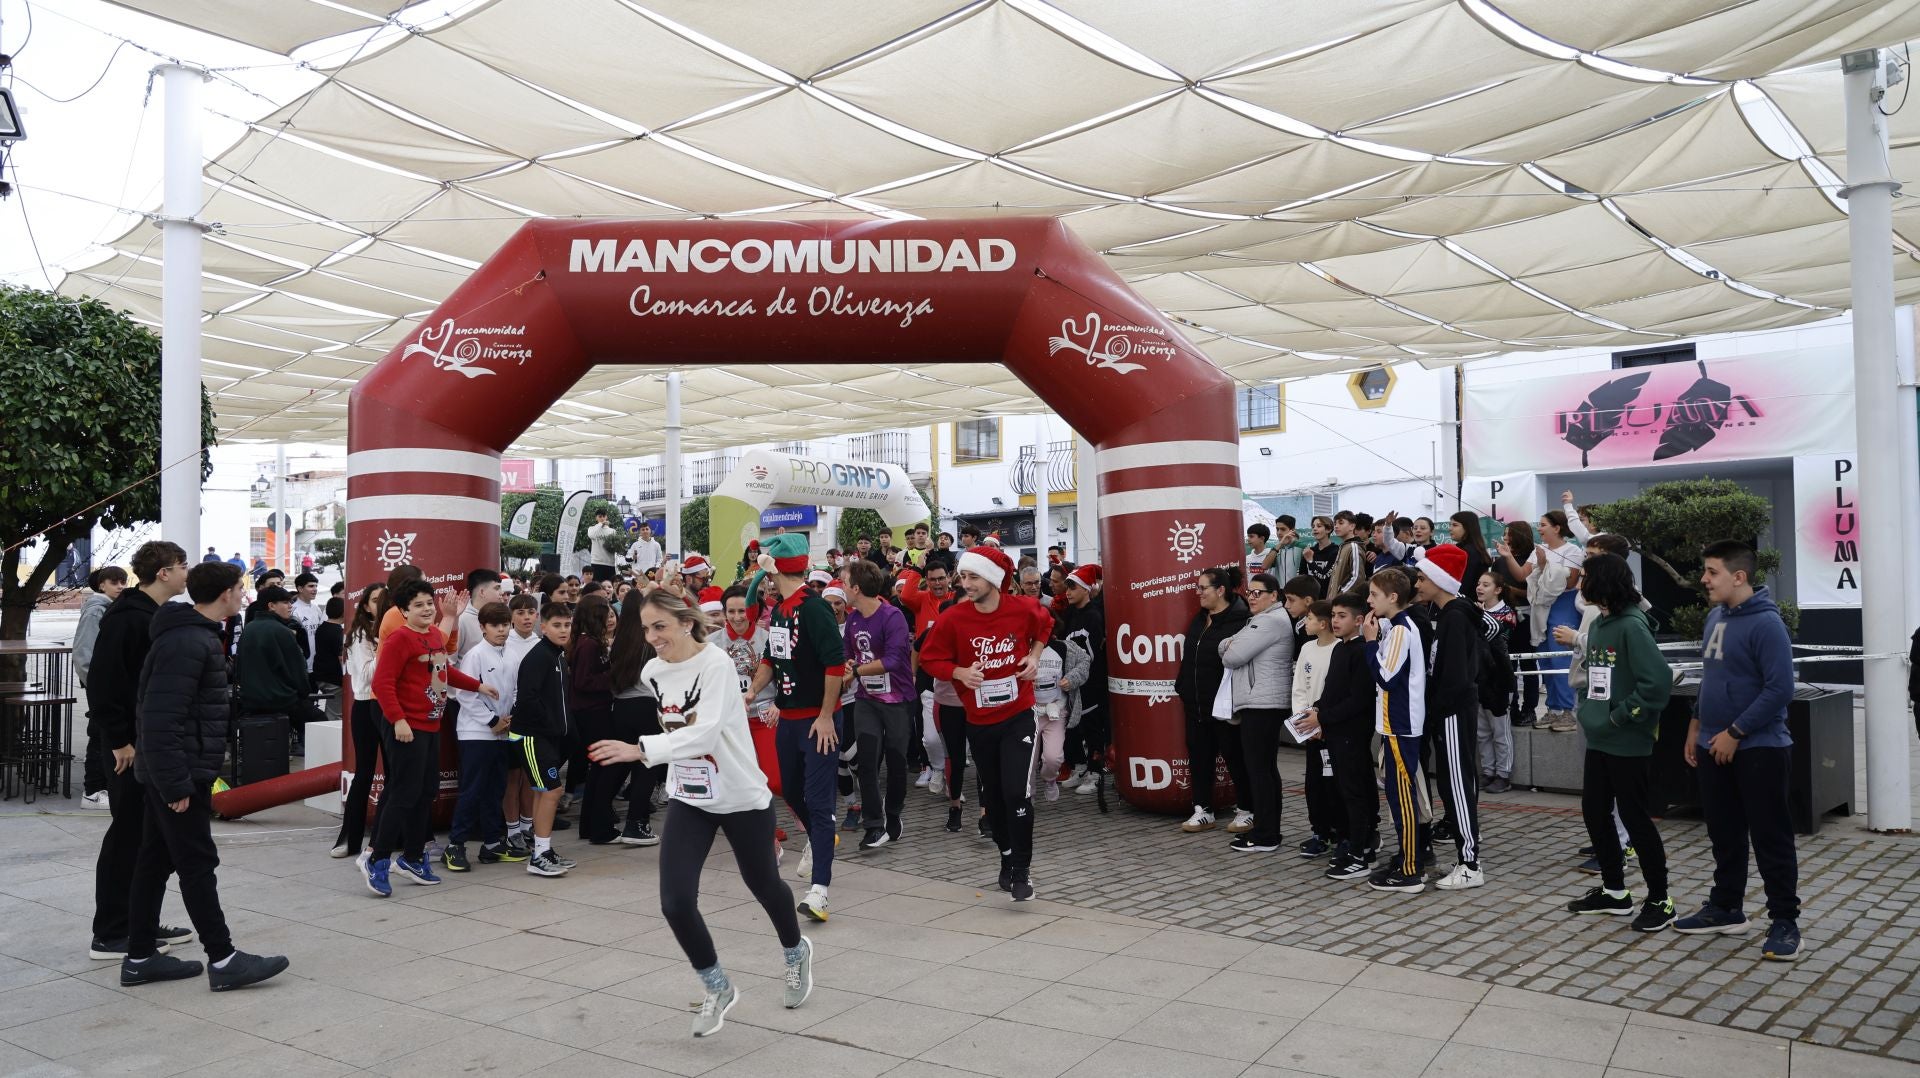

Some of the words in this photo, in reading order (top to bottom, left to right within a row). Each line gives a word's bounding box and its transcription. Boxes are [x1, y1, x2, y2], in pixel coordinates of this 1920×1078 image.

[569, 239, 1016, 273] MANCOMUNIDAD
[629, 285, 756, 317] Comarca
[766, 286, 796, 317] de
[808, 285, 934, 328] Olivenza
[789, 459, 891, 489] PROGRIFO
[745, 482, 774, 490] PROMEDIO
[789, 485, 819, 494] EVENTOS
[821, 488, 835, 496] CON
[836, 490, 854, 498] AGUA
[870, 493, 888, 501] GRIFO
[1834, 460, 1858, 589] PLUMA
[446, 572, 464, 581] Real
[1130, 574, 1176, 590] Deportistas
[1178, 572, 1192, 584] por
[1194, 569, 1201, 577] la
[1143, 588, 1164, 599] entre
[1166, 582, 1196, 595] Mujeres
[995, 638, 1015, 654] the
[1704, 622, 1727, 660] A
